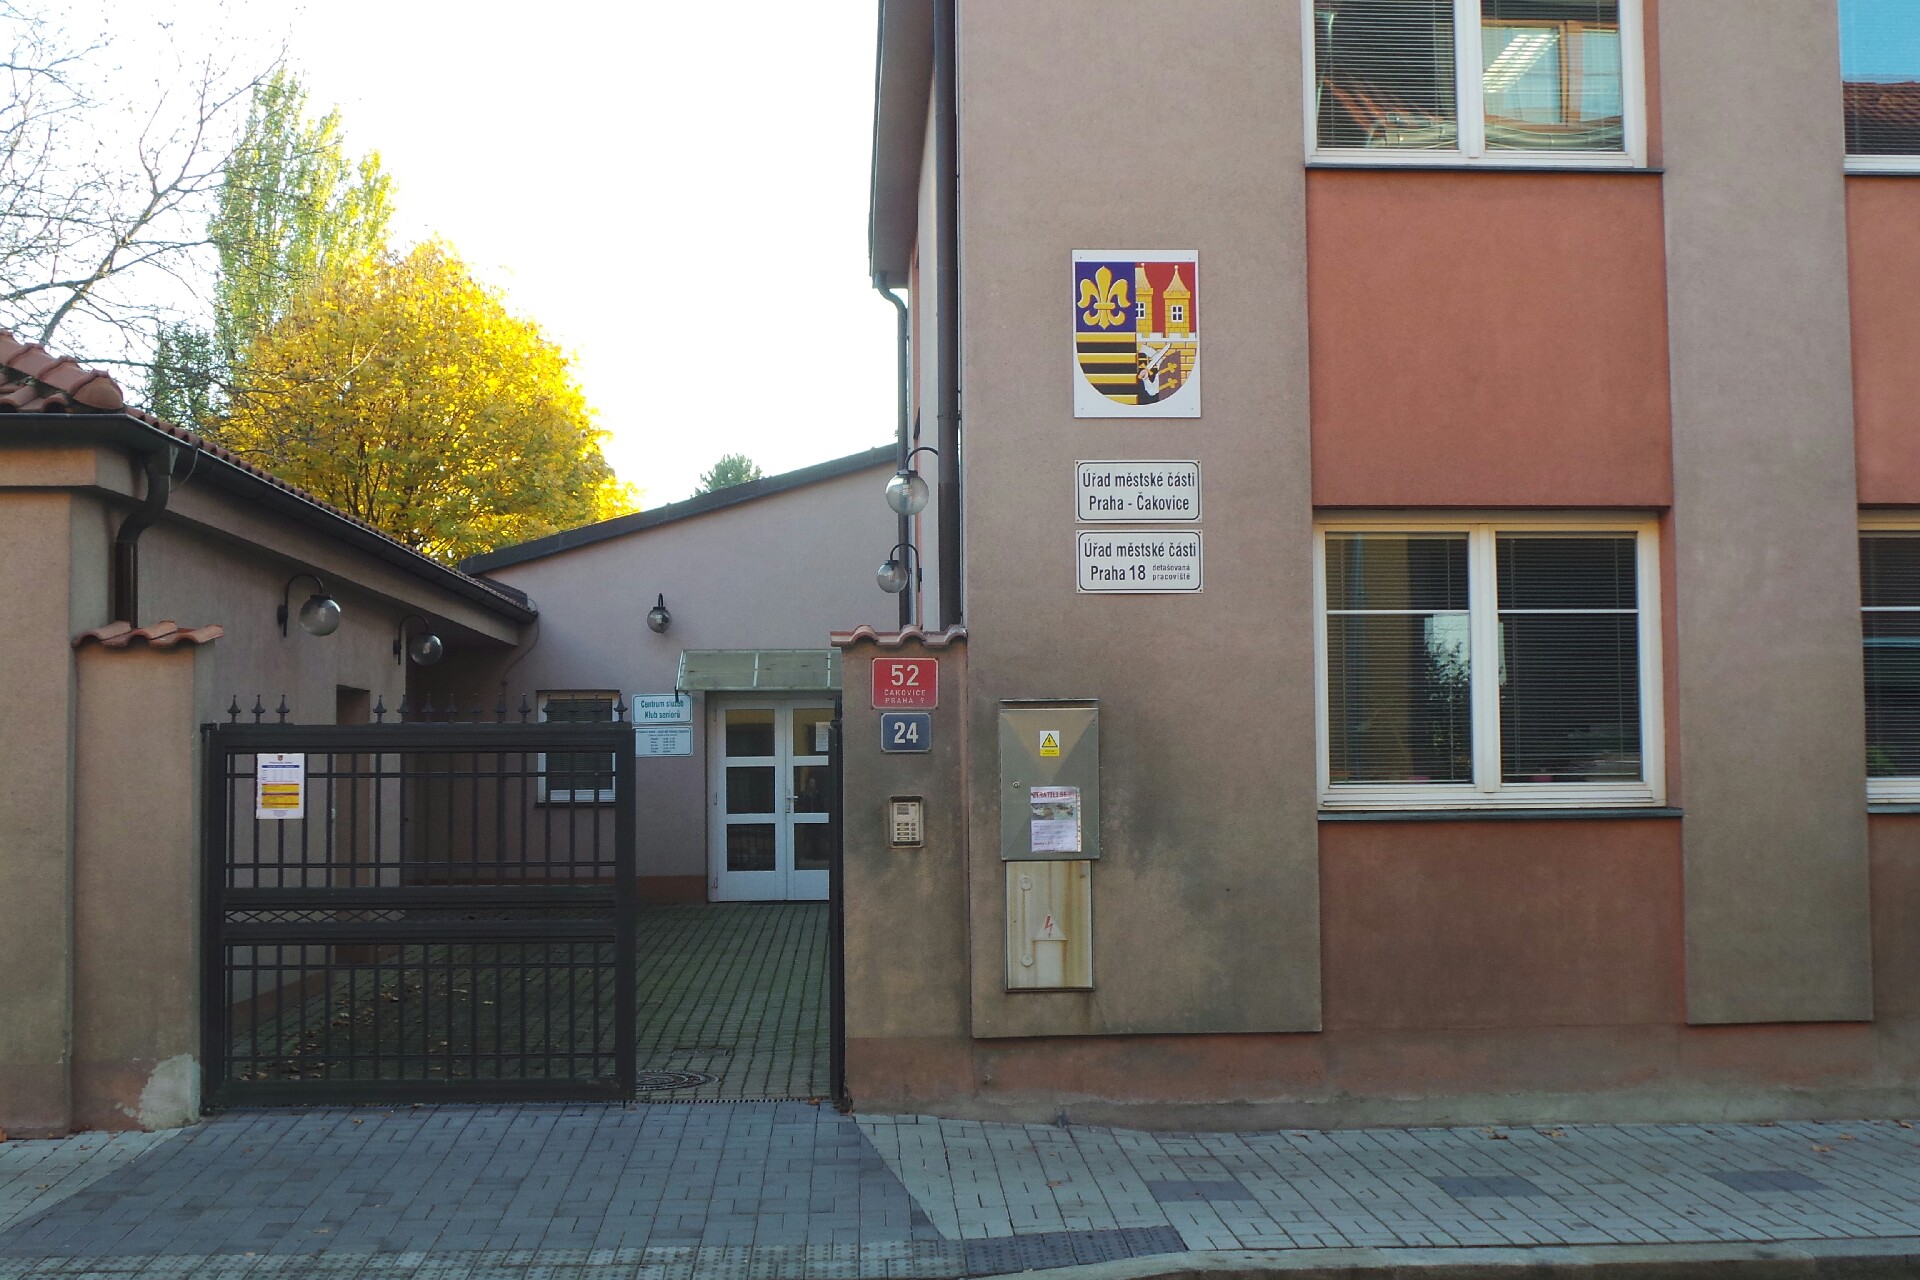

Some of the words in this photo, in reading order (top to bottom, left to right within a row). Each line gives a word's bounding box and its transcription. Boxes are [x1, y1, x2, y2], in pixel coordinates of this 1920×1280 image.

[1083, 468, 1111, 487] Úřad
[1115, 472, 1164, 487] městské
[1167, 472, 1195, 487] části
[1089, 495, 1124, 510] Praha
[1137, 491, 1189, 510] Čakovice
[1084, 538, 1112, 557] Úřad
[1116, 542, 1165, 557] městské
[1168, 542, 1196, 557] části
[1091, 565, 1126, 580] Praha
[1128, 564, 1146, 580] 18
[891, 664, 919, 686] 52
[640, 700, 665, 708] Centrum
[893, 721, 919, 743] 24
